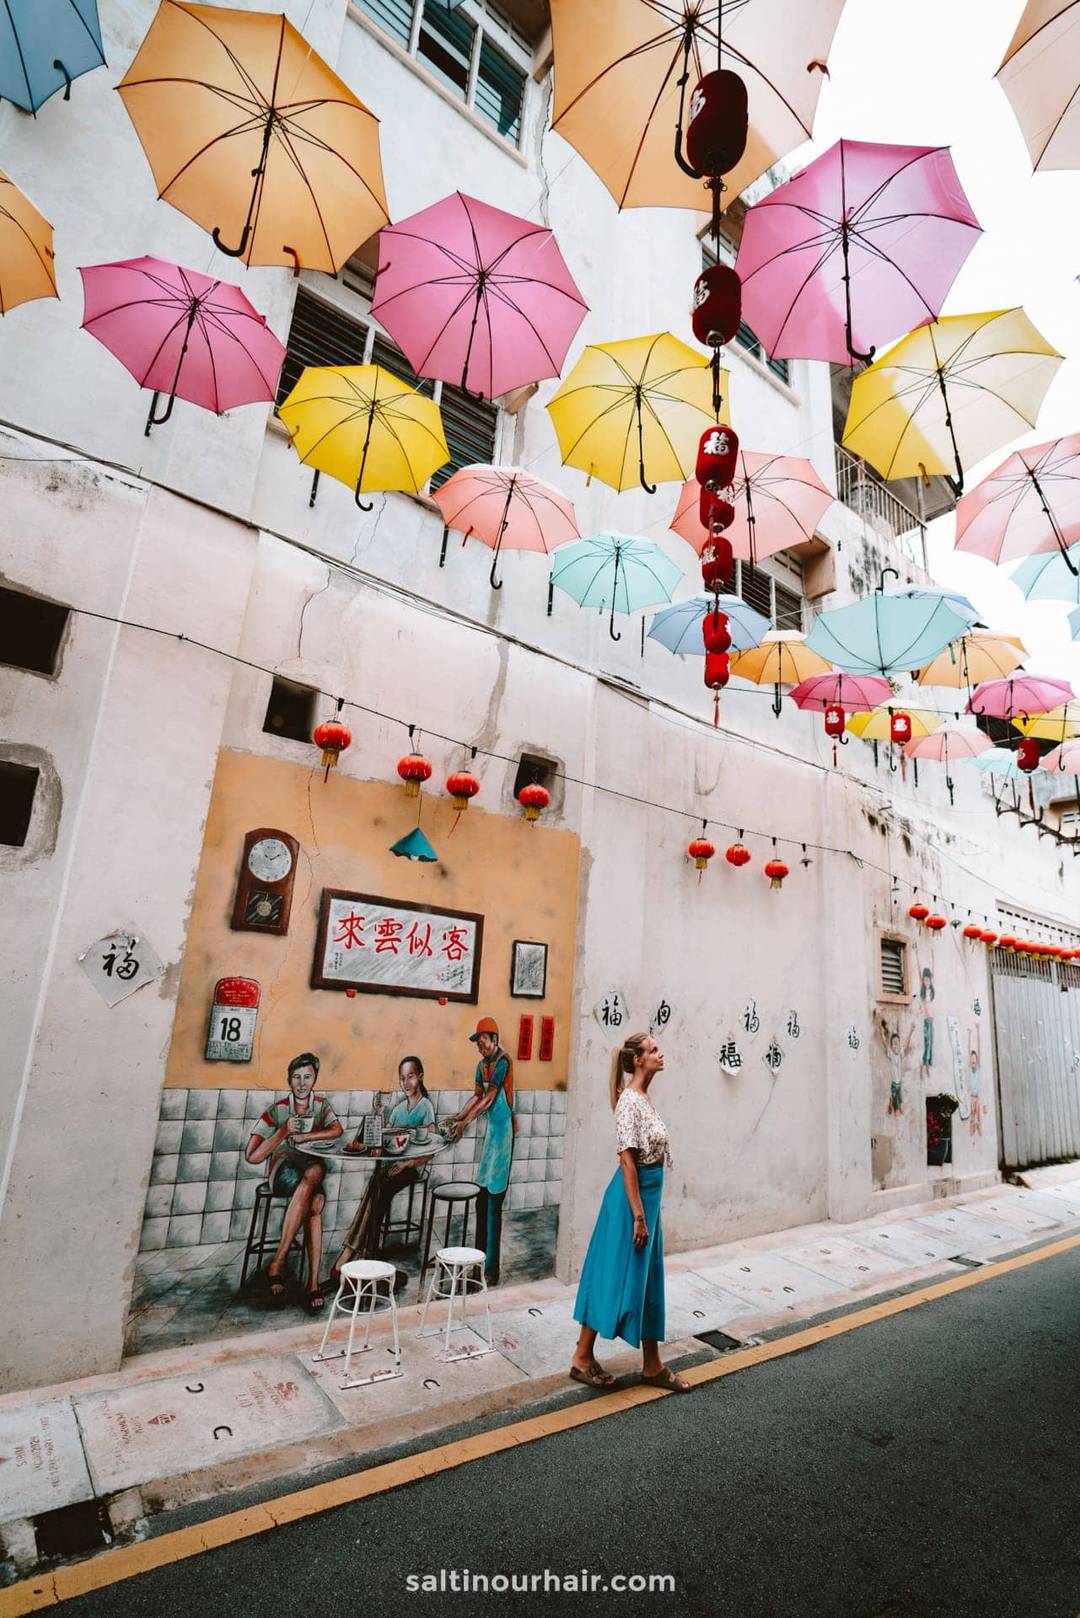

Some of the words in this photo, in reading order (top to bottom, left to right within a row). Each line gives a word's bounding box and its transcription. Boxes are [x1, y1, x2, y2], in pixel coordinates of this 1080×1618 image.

[704, 432, 729, 455] 福
[102, 938, 139, 980] 福
[602, 995, 622, 1026] 福
[744, 1001, 760, 1033] 福
[221, 1017, 241, 1041] 18
[719, 1041, 741, 1067] 福
